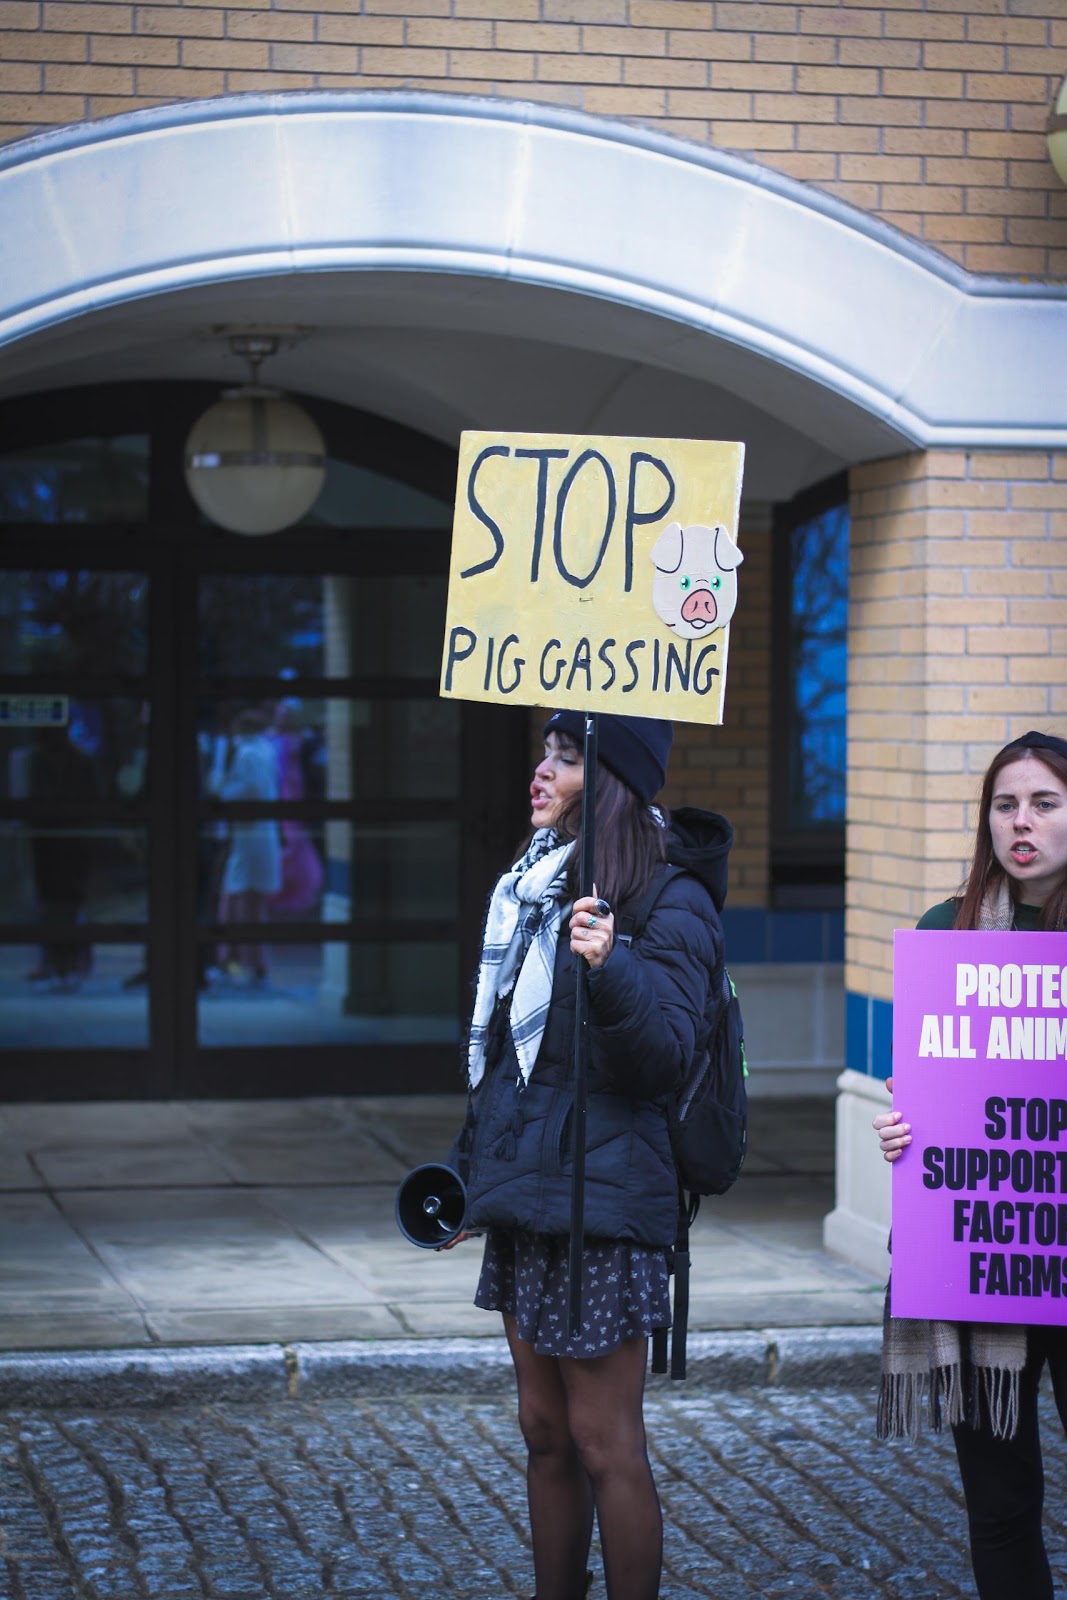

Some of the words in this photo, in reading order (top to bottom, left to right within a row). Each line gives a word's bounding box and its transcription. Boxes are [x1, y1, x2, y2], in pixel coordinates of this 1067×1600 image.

[460, 445, 676, 592] STOP
[444, 626, 525, 694] PIG
[539, 637, 719, 695] GASSING
[918, 1014, 977, 1059] ALL
[984, 1096, 1067, 1142] STOP
[970, 1251, 1067, 1298] FARM
